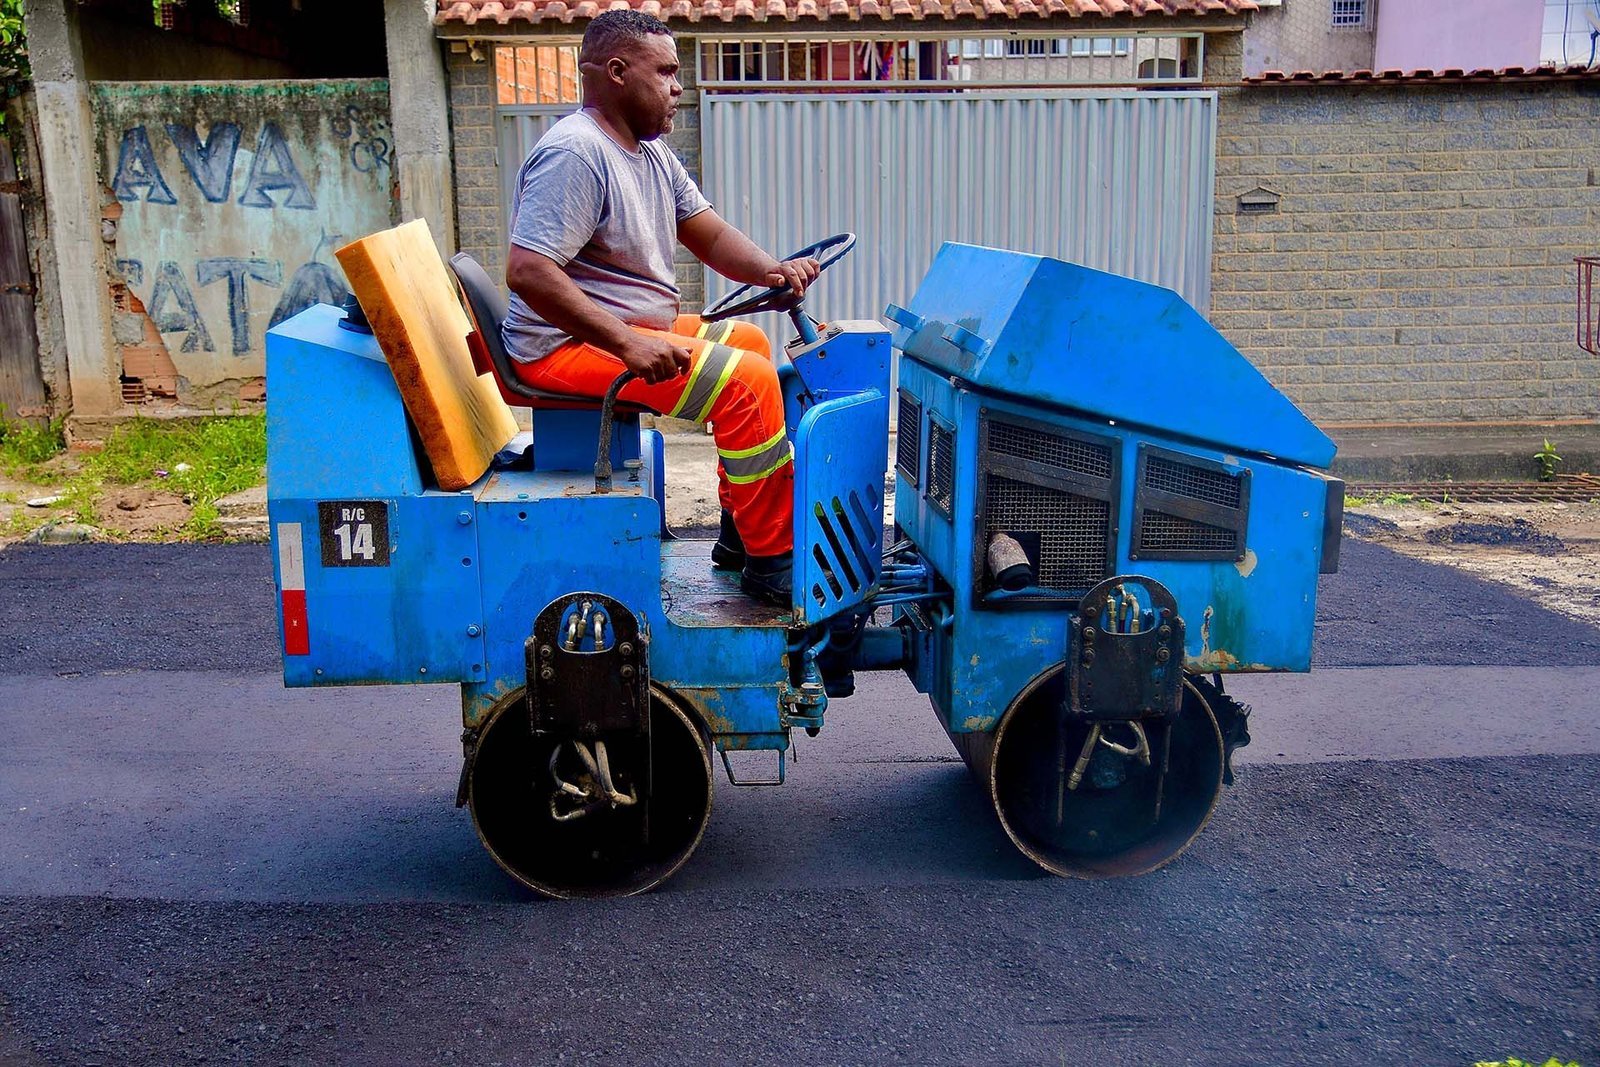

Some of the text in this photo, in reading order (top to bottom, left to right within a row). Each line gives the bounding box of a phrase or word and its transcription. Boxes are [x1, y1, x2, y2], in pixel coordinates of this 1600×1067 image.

[111, 121, 317, 210] AVA
[341, 507, 366, 521] R/C
[334, 523, 376, 560] 14
